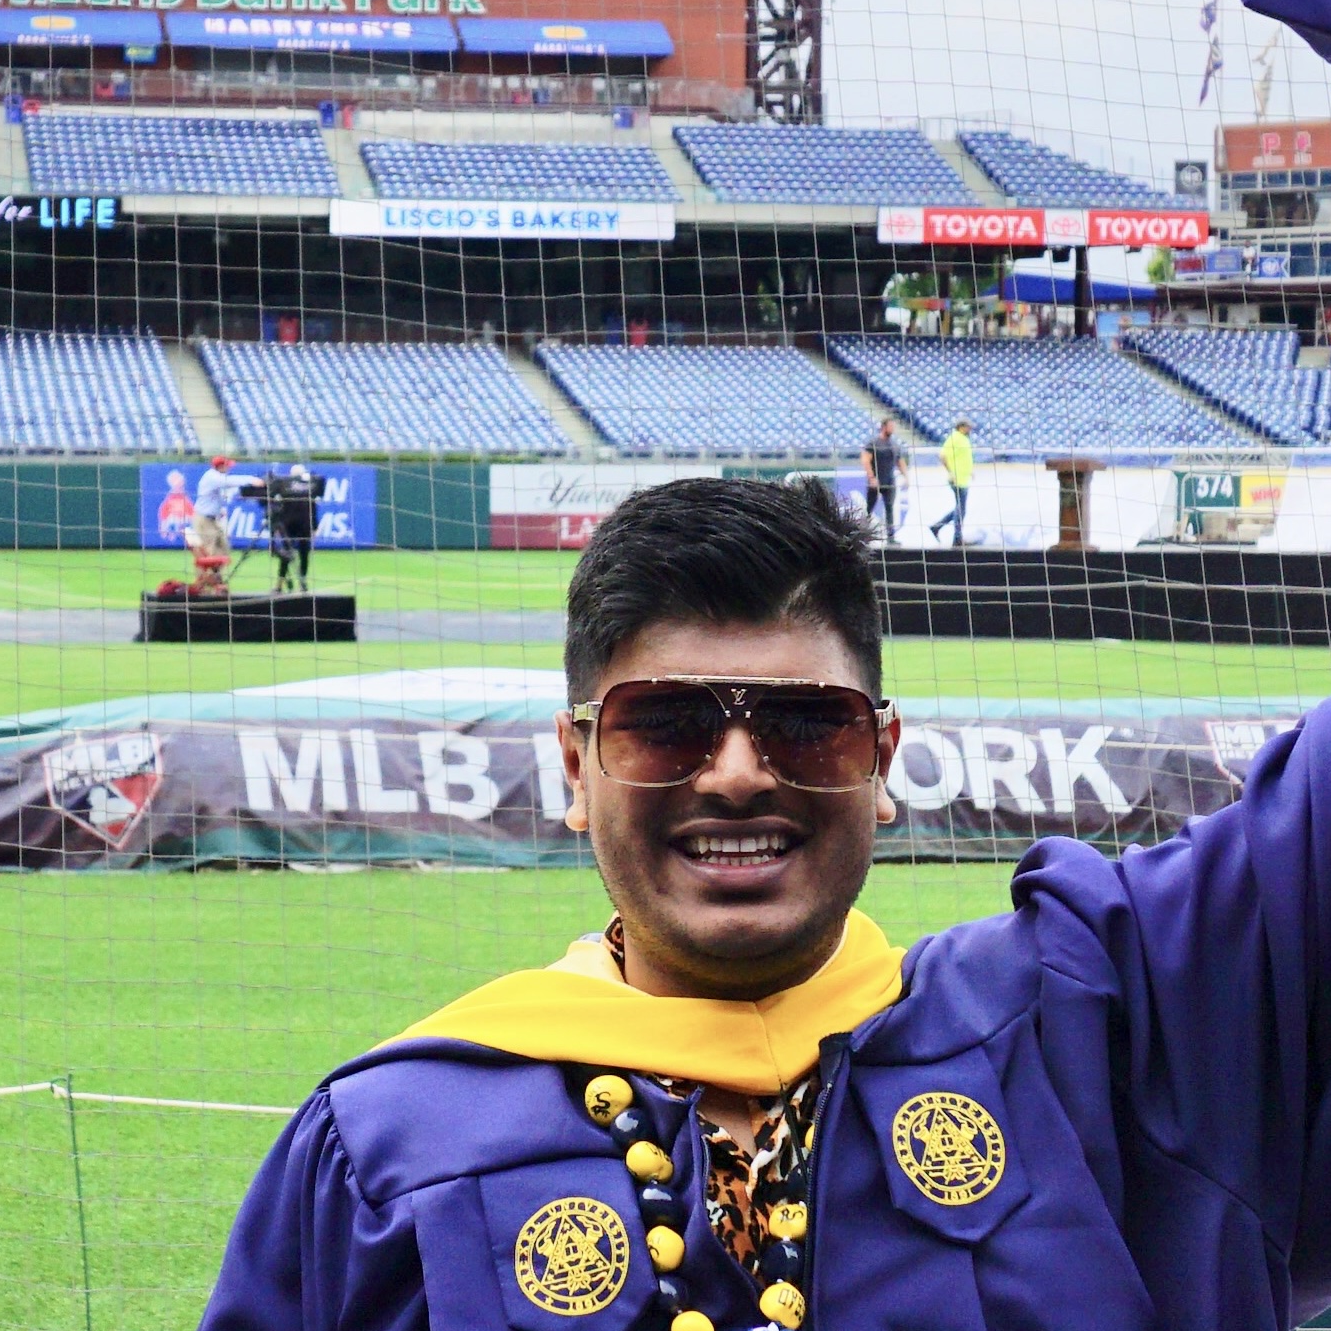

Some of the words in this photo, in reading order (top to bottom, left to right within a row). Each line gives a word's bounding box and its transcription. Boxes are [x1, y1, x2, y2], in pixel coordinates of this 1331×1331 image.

[38, 197, 115, 229] LIFE
[383, 207, 500, 228] LISCIO'S
[511, 209, 620, 230] BAKERY
[929, 213, 1038, 239] TOYOTA
[1095, 216, 1201, 242] TOYOTA
[238, 728, 500, 821] MLB
